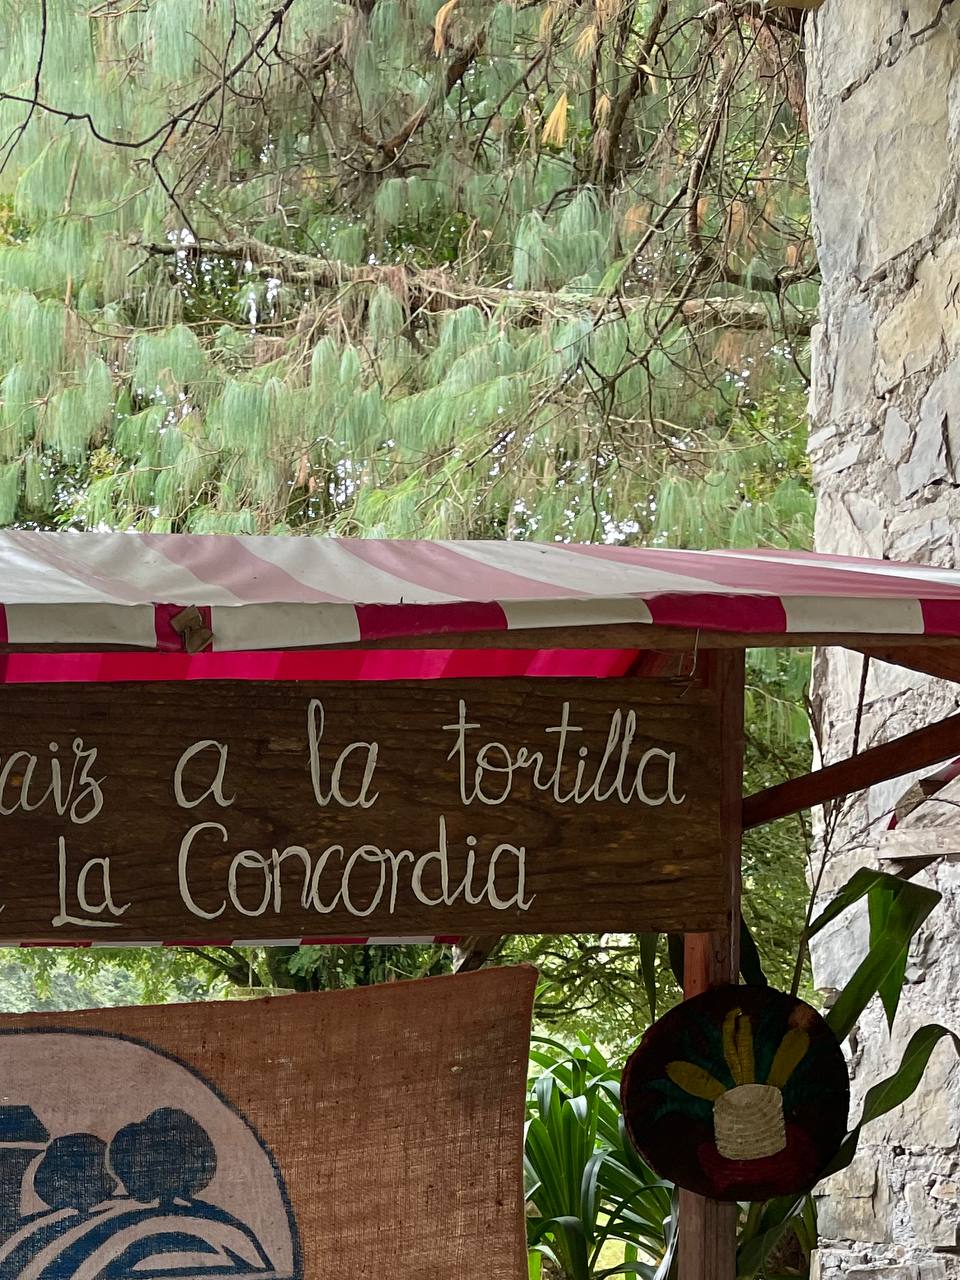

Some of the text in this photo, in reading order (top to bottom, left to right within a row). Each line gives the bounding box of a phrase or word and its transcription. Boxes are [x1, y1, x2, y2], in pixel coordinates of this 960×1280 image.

[174, 739, 236, 809] a
[307, 698, 379, 809] la
[442, 699, 686, 805] tortilla
[50, 835, 132, 928] La
[177, 814, 536, 920] Concordia
